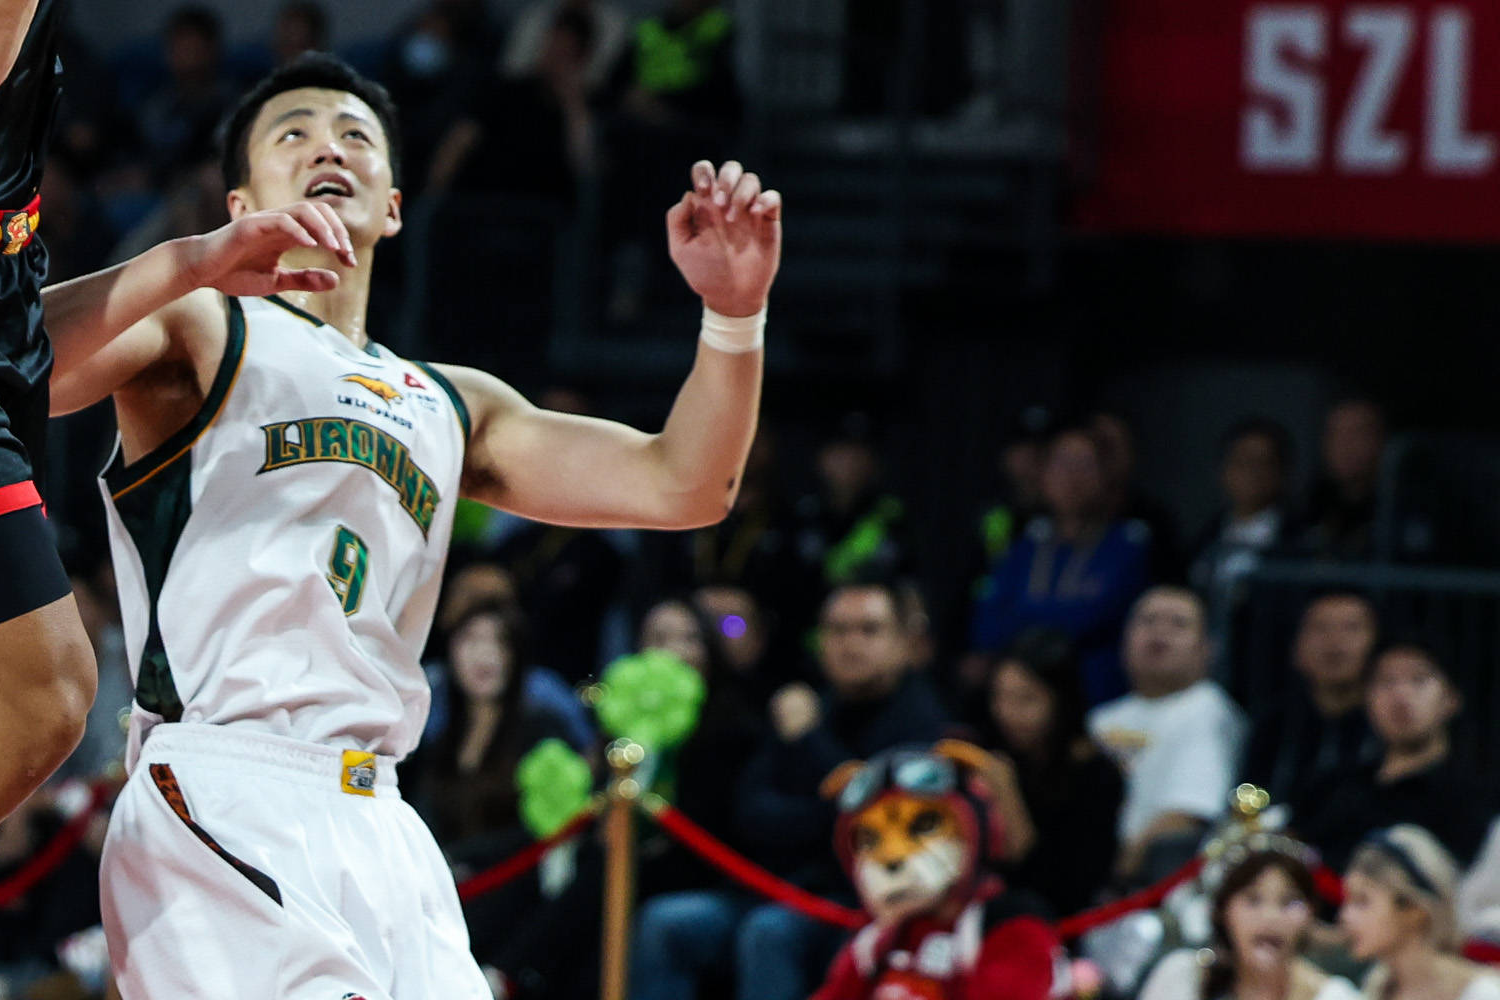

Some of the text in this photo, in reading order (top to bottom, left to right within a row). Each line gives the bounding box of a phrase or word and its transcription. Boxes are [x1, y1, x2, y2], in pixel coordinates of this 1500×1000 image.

[1241, 4, 1496, 174] SZL
[256, 416, 441, 546] LIAONING
[325, 524, 369, 617] 9
